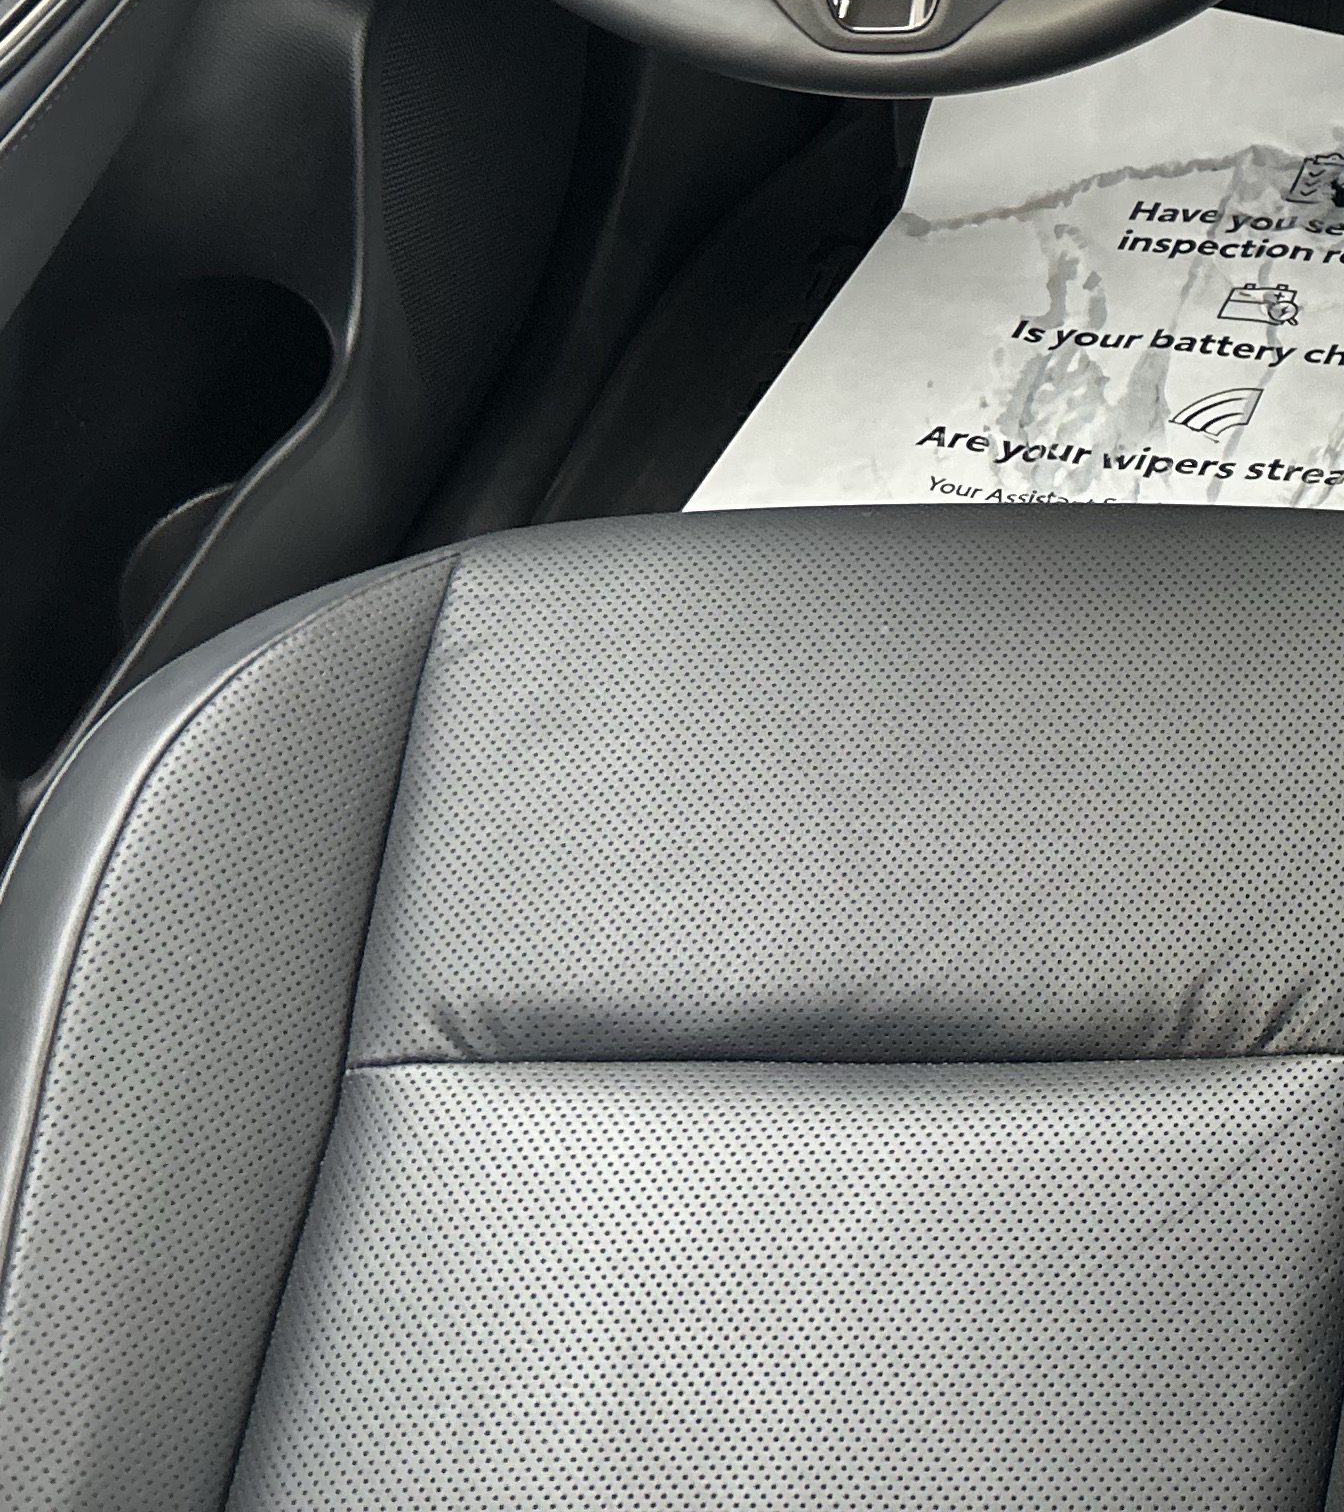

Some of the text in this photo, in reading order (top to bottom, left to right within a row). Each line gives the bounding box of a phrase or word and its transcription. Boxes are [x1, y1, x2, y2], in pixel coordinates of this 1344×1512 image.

[1128, 199, 1219, 225] Have
[1226, 211, 1298, 234] you
[1117, 228, 1313, 263] inspection
[1011, 319, 1046, 343] Is
[1047, 329, 1142, 351] your
[1149, 328, 1297, 368] battery
[915, 425, 991, 453] Are
[994, 439, 1093, 465] your
[1103, 446, 1237, 479] wipers
[928, 475, 1095, 504] Your Assist
